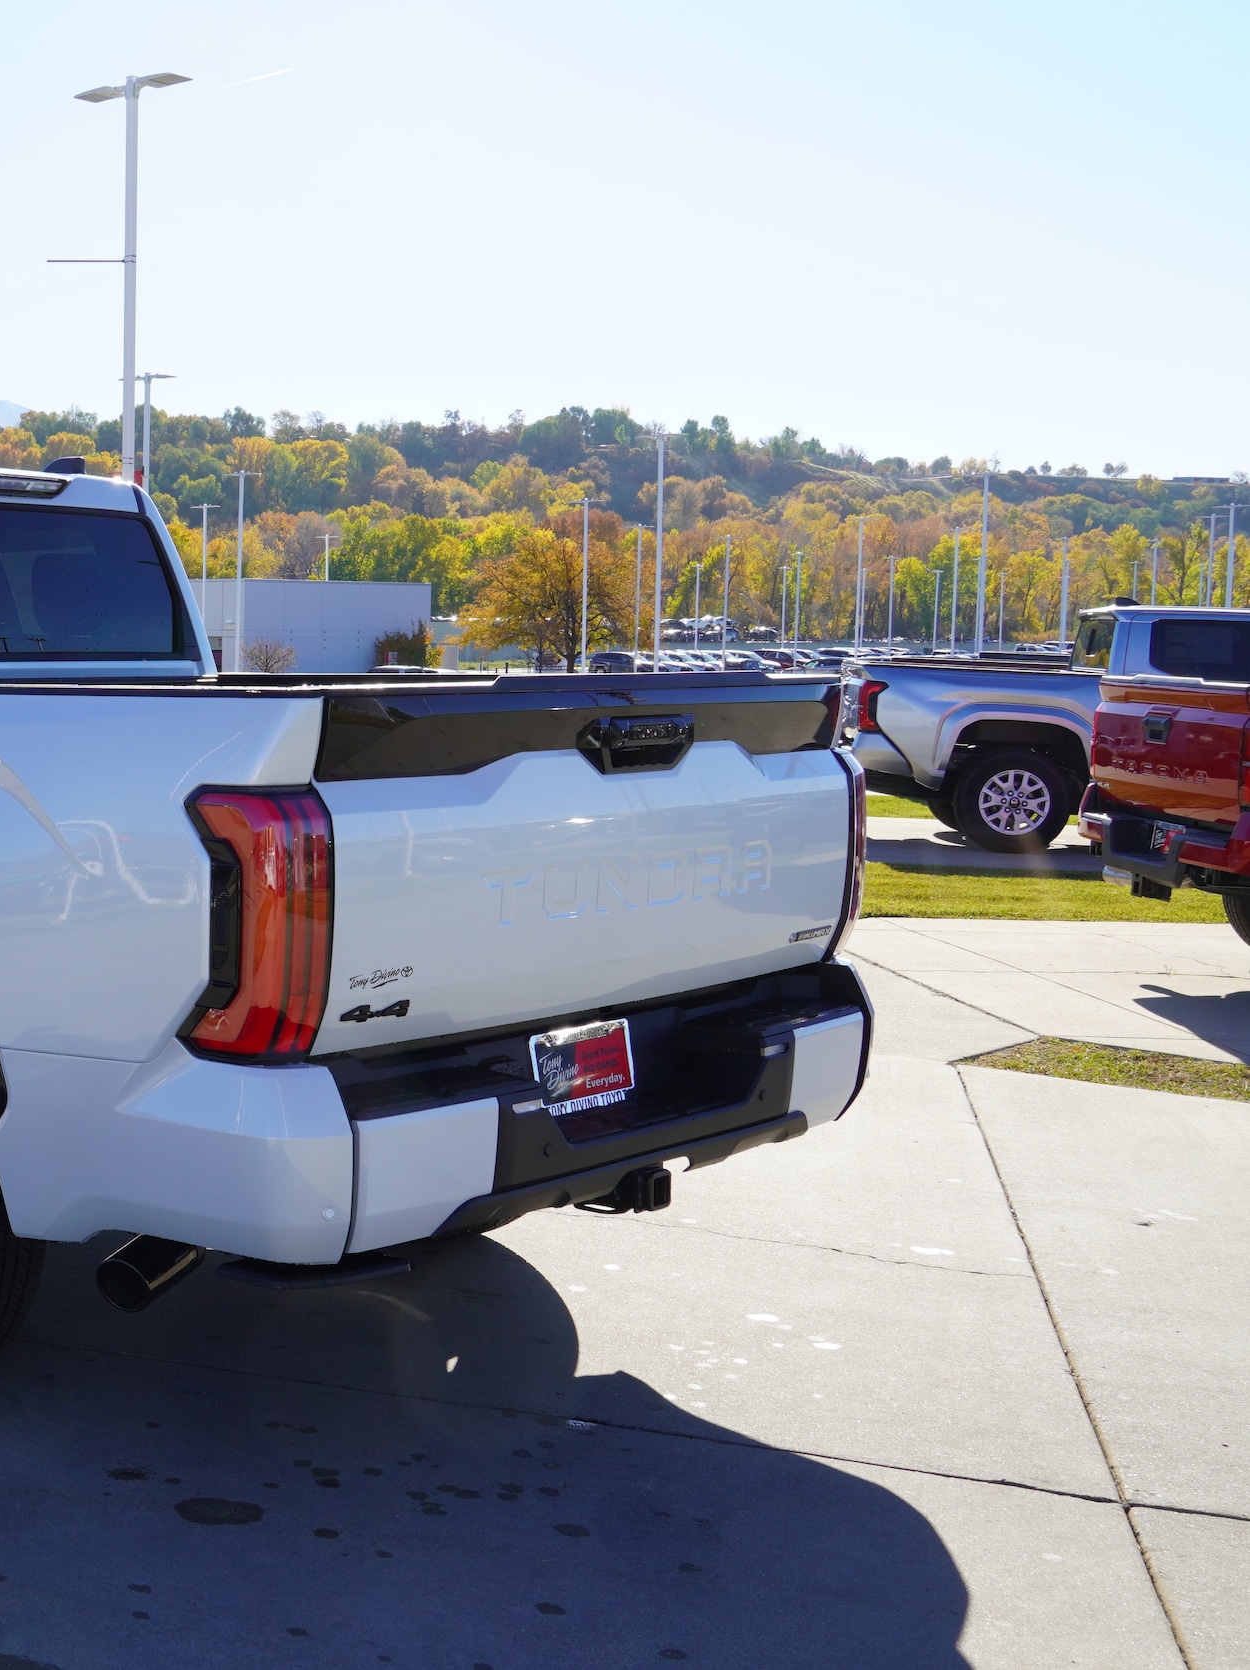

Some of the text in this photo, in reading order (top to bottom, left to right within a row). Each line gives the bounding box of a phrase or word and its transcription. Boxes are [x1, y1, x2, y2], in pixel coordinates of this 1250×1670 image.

[1111, 756, 1209, 785] TACOMA
[481, 839, 771, 926] TUNDRA
[349, 967, 401, 990] Tony Divino
[339, 999, 411, 1023] 4x4
[539, 1051, 563, 1075] Tony
[584, 1063, 595, 1072] NO
[544, 1064, 580, 1090] Divino
[585, 1072, 626, 1089] Everyday.
[570, 1096, 599, 1112] DIVINO
[600, 1089, 627, 1106] TOYOT
